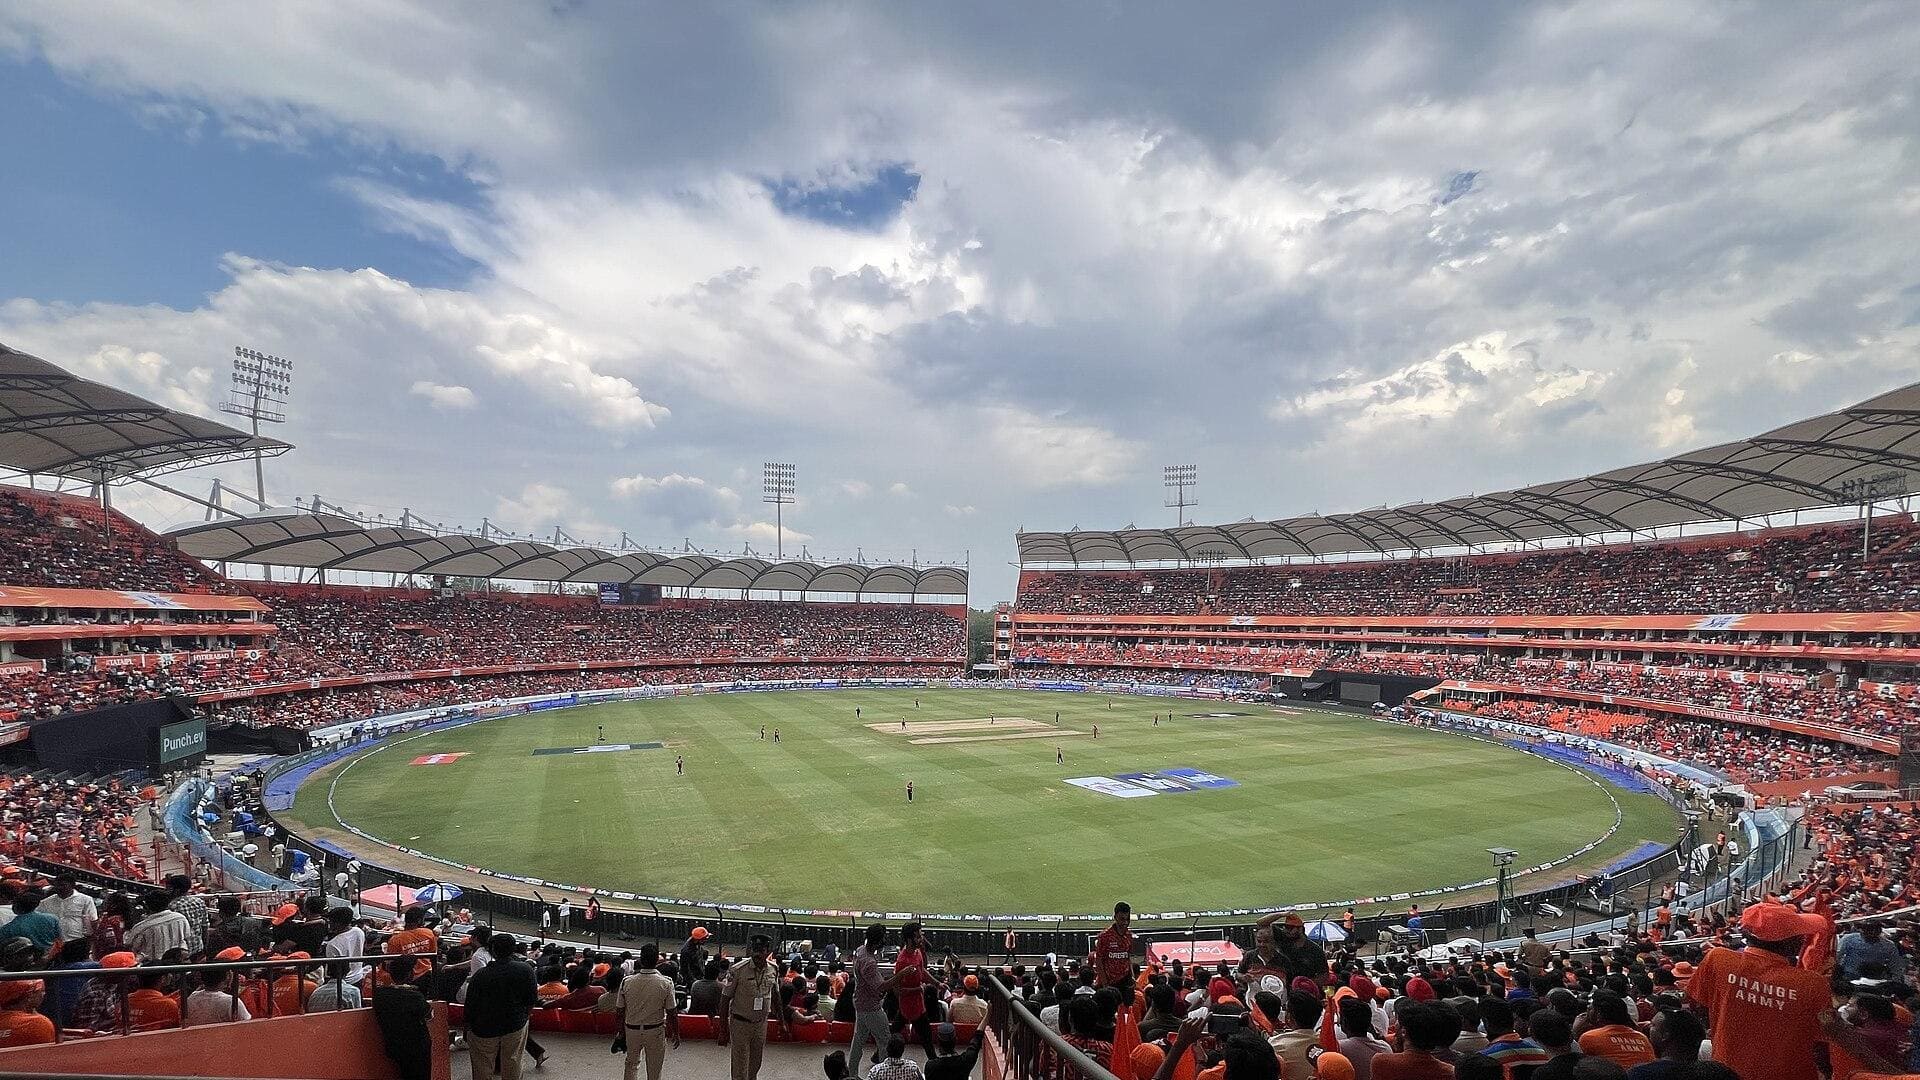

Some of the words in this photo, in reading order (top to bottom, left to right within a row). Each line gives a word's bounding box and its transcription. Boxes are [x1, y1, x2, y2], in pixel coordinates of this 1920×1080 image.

[163, 731, 204, 753] Punch.ev
[1727, 973, 1798, 1001] ORANGE
[1735, 989, 1785, 1011] ARMY
